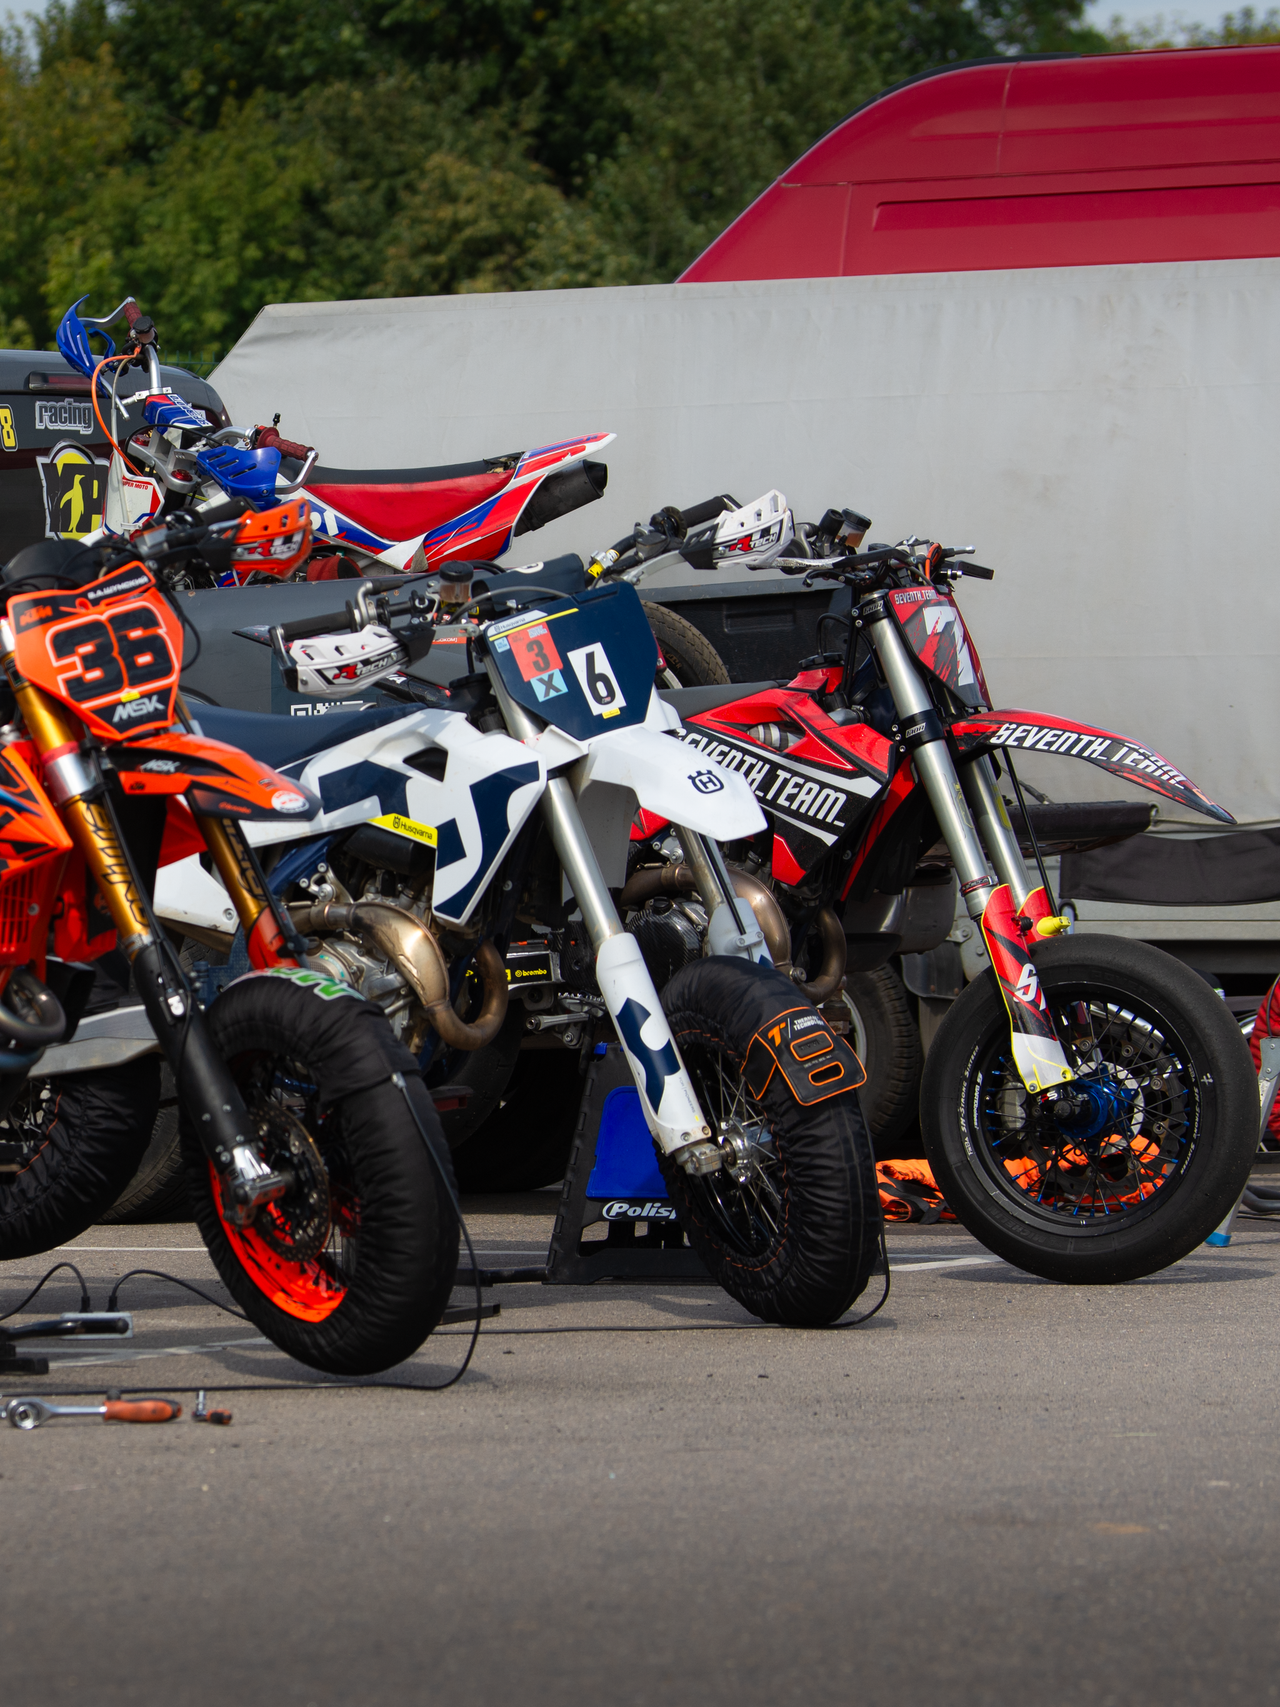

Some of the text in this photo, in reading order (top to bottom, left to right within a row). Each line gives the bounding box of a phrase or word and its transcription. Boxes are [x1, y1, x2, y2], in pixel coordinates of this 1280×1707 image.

[36, 398, 94, 434] racing
[47, 602, 179, 708] 36
[526, 639, 551, 673] 3
[536, 672, 563, 699] X
[585, 651, 616, 706] 6
[112, 695, 166, 724] MSK
[140, 758, 181, 774] MSK
[400, 820, 433, 840] Husqvarna
[522, 968, 547, 977] brembo
